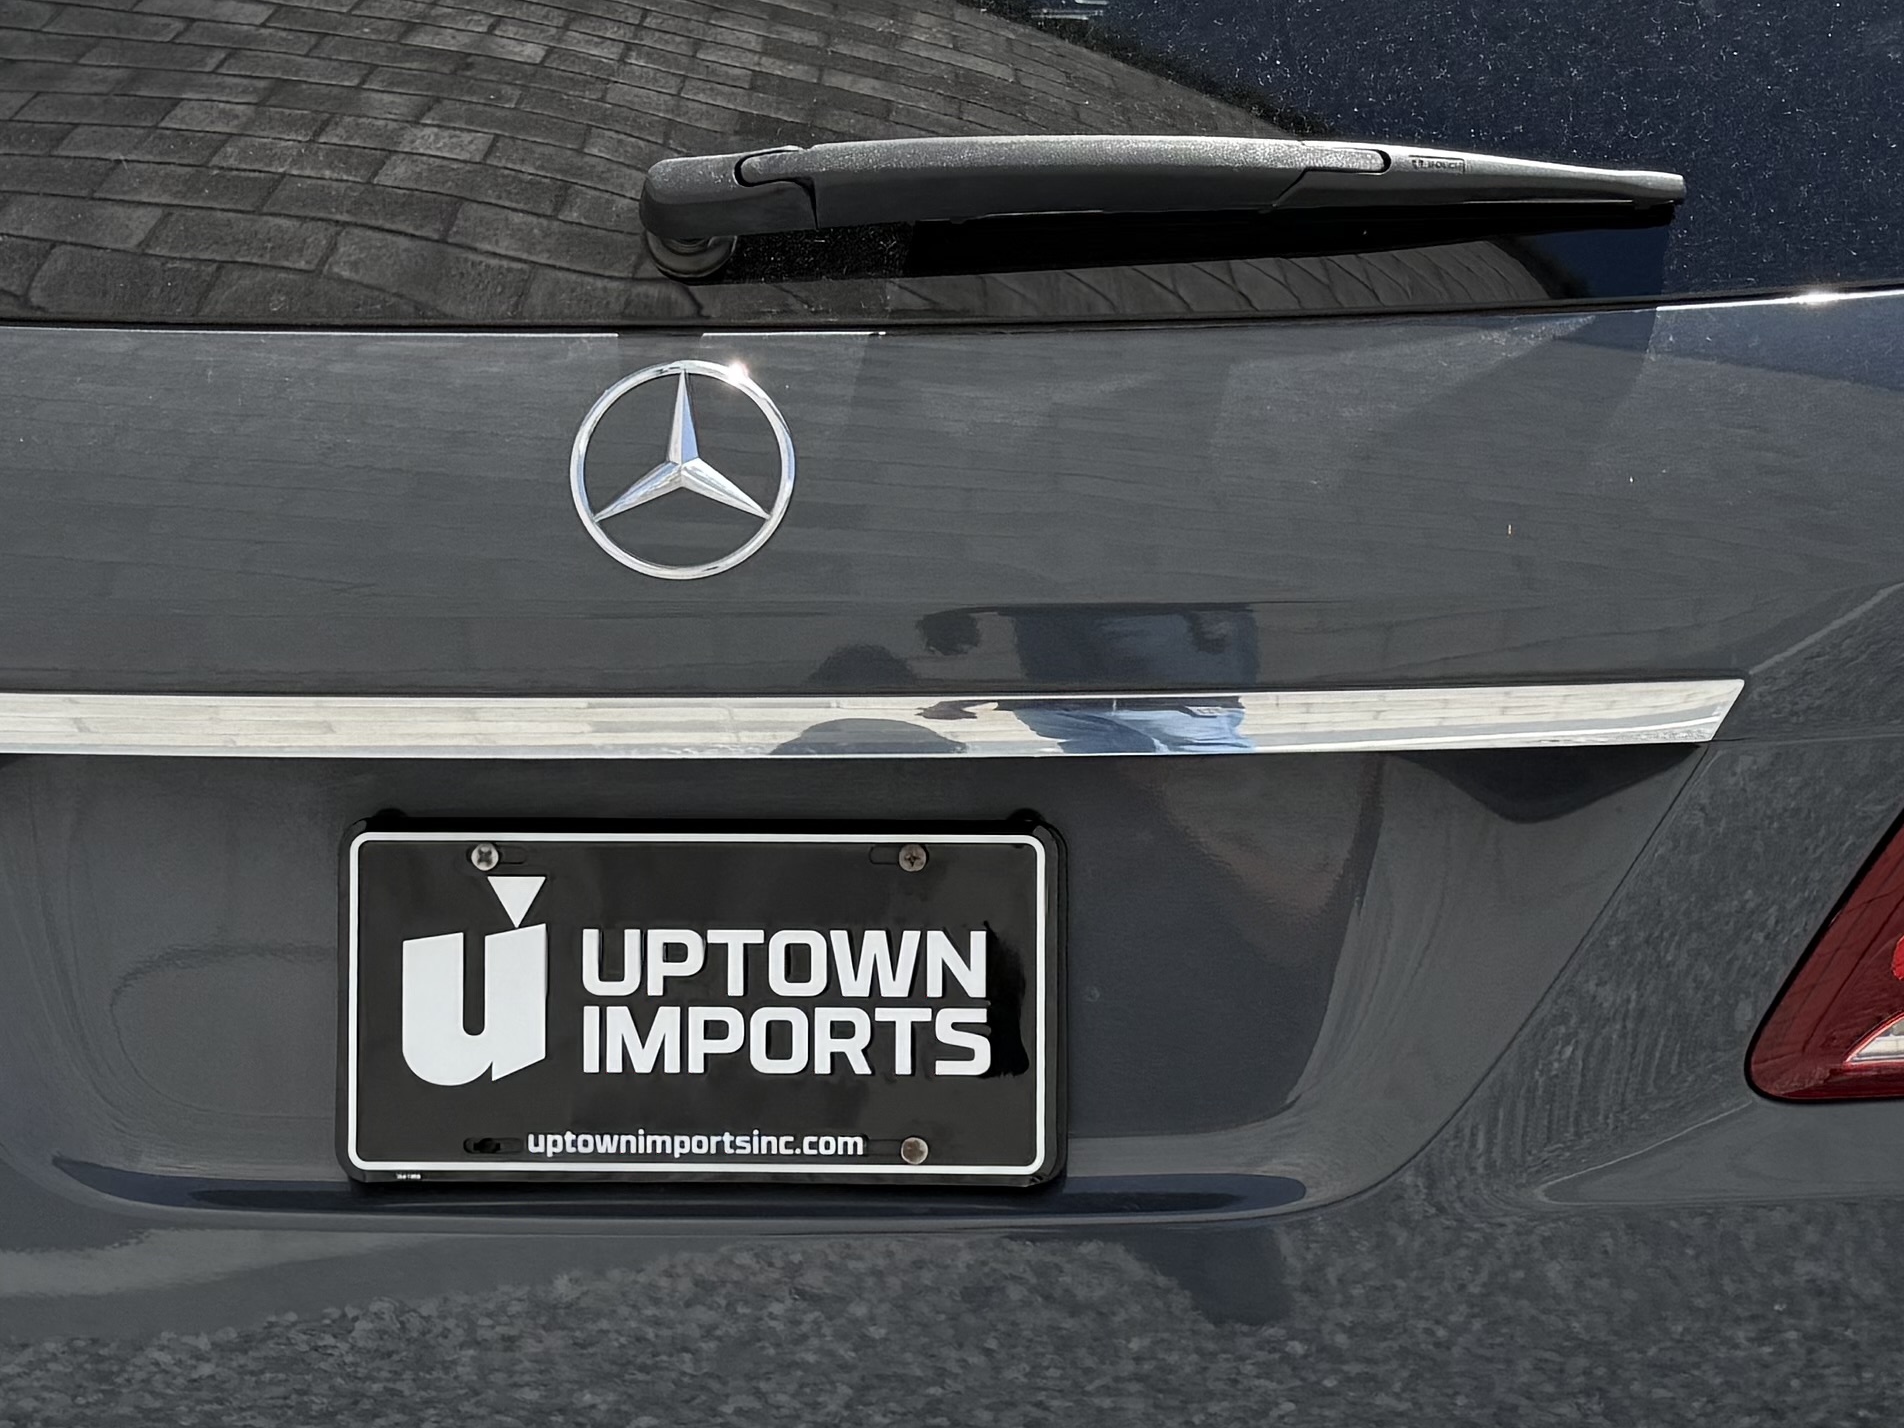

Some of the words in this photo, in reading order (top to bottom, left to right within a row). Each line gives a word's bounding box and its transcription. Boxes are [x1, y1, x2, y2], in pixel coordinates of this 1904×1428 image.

[582, 928, 988, 999] UPTOWN
[582, 1006, 992, 1077] IMPORTS
[527, 1129, 864, 1157] uptownimportsinc.com
